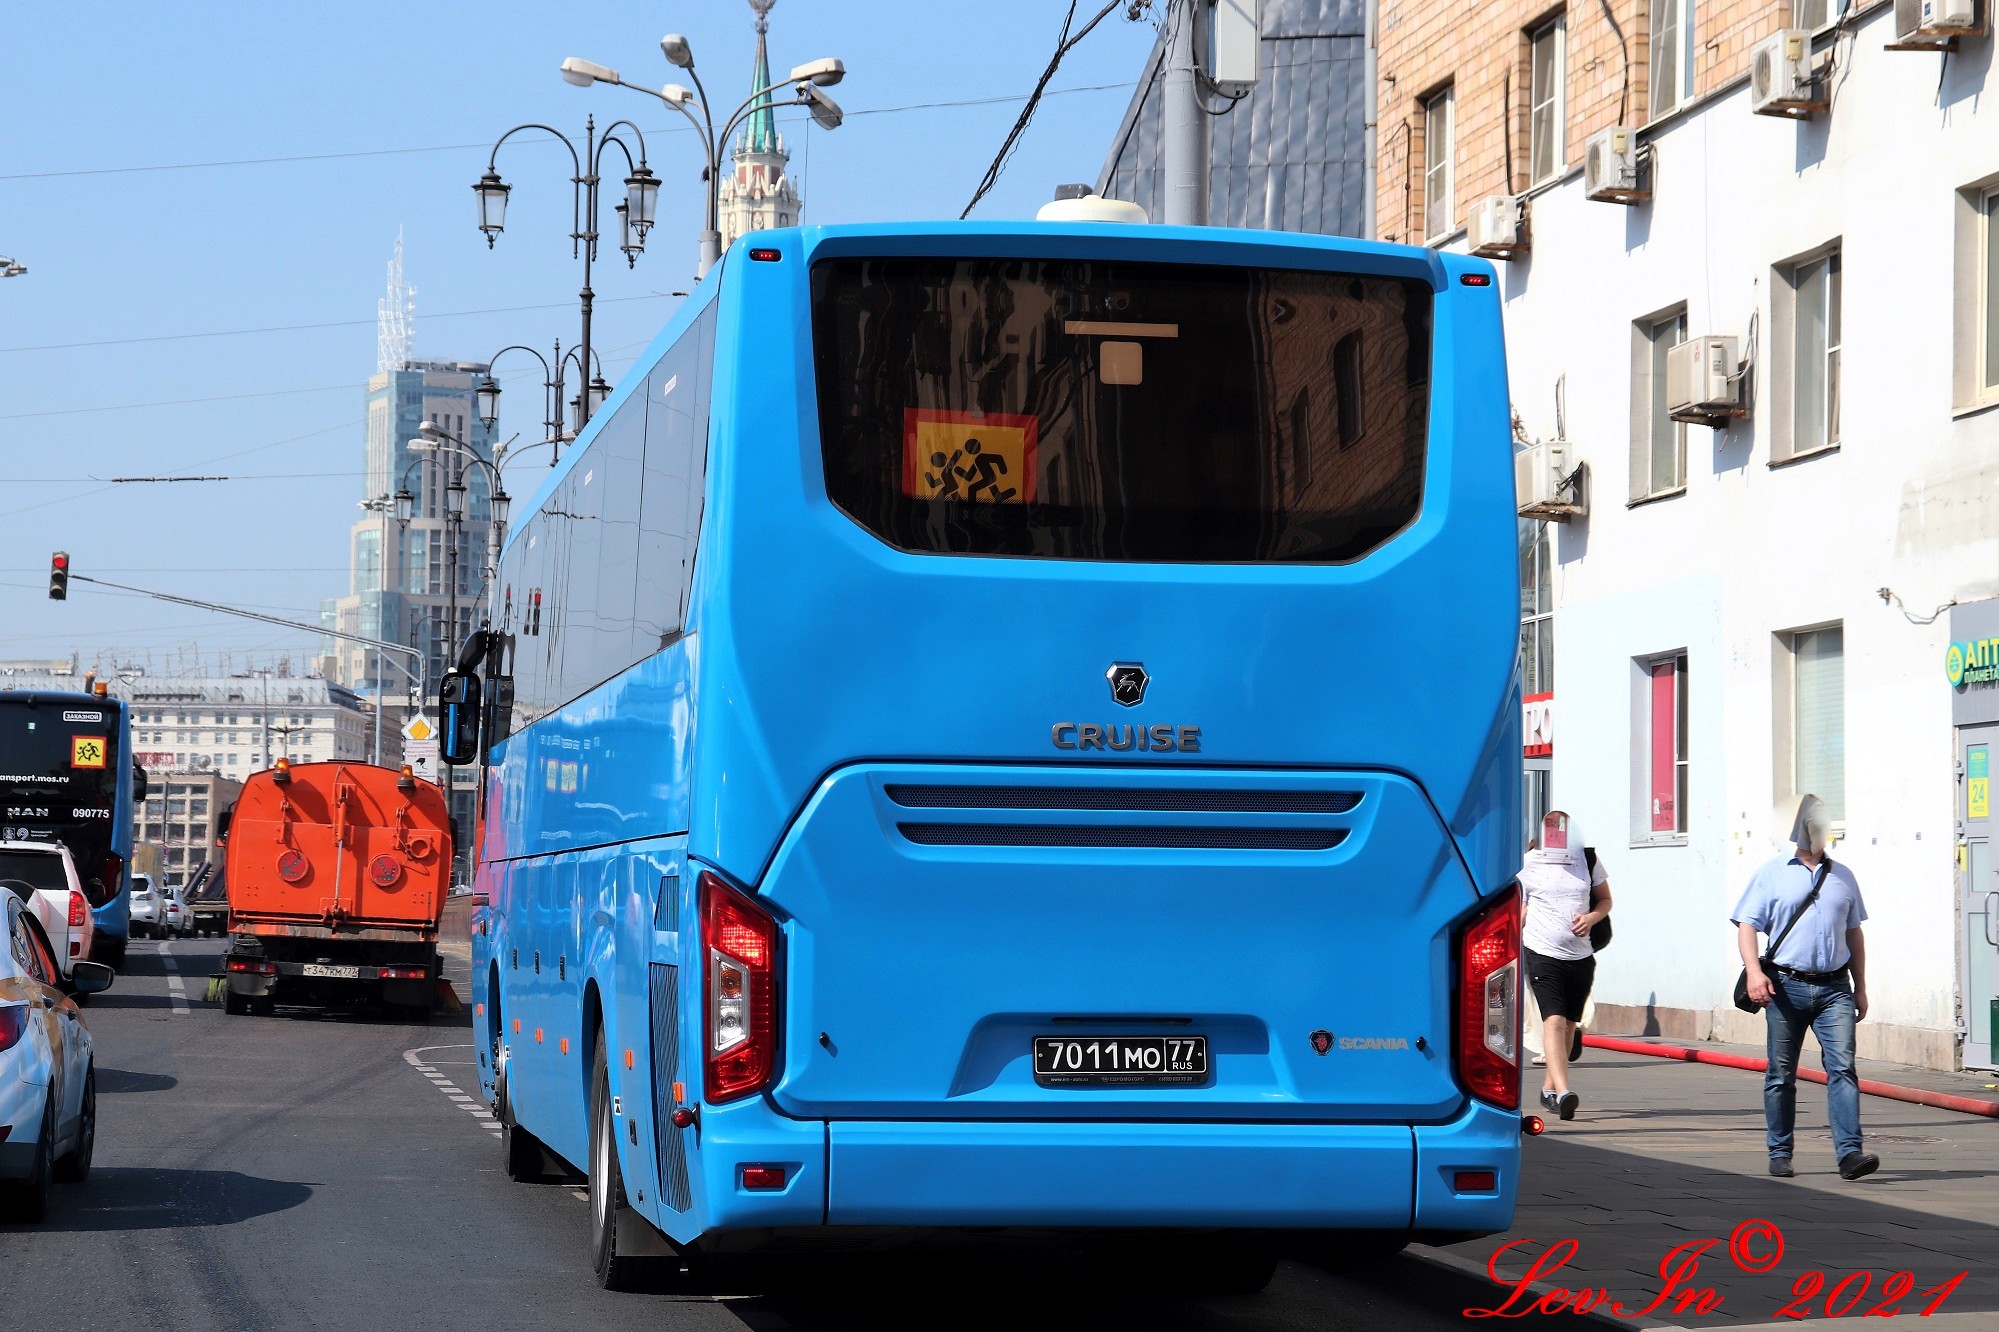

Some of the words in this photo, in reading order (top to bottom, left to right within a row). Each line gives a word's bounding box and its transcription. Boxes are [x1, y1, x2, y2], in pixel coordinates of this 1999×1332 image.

[1052, 722, 1200, 752] CRUISE
[1973, 783, 1985, 804] 24
[7, 807, 49, 817] MAN
[72, 808, 110, 819] 090775
[1339, 1037, 1409, 1050] SCANIA
[1168, 1040, 1196, 1062] 77
[1172, 1062, 1193, 1070] RUS
